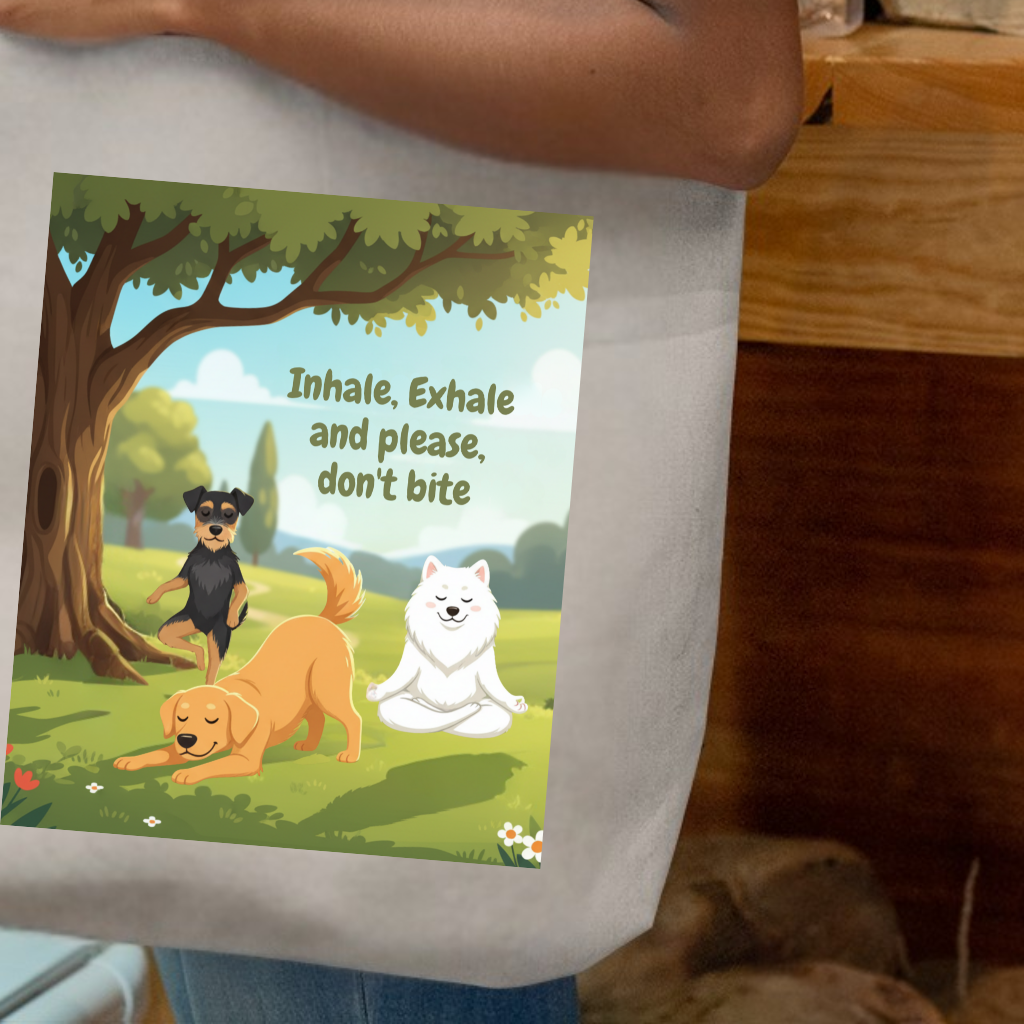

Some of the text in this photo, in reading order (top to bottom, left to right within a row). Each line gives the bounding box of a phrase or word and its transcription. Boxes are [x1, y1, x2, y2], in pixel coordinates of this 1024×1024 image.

[287, 367, 515, 415] Inhale, Exhale
[309, 417, 486, 464] and please,
[317, 461, 471, 506] don't bite
